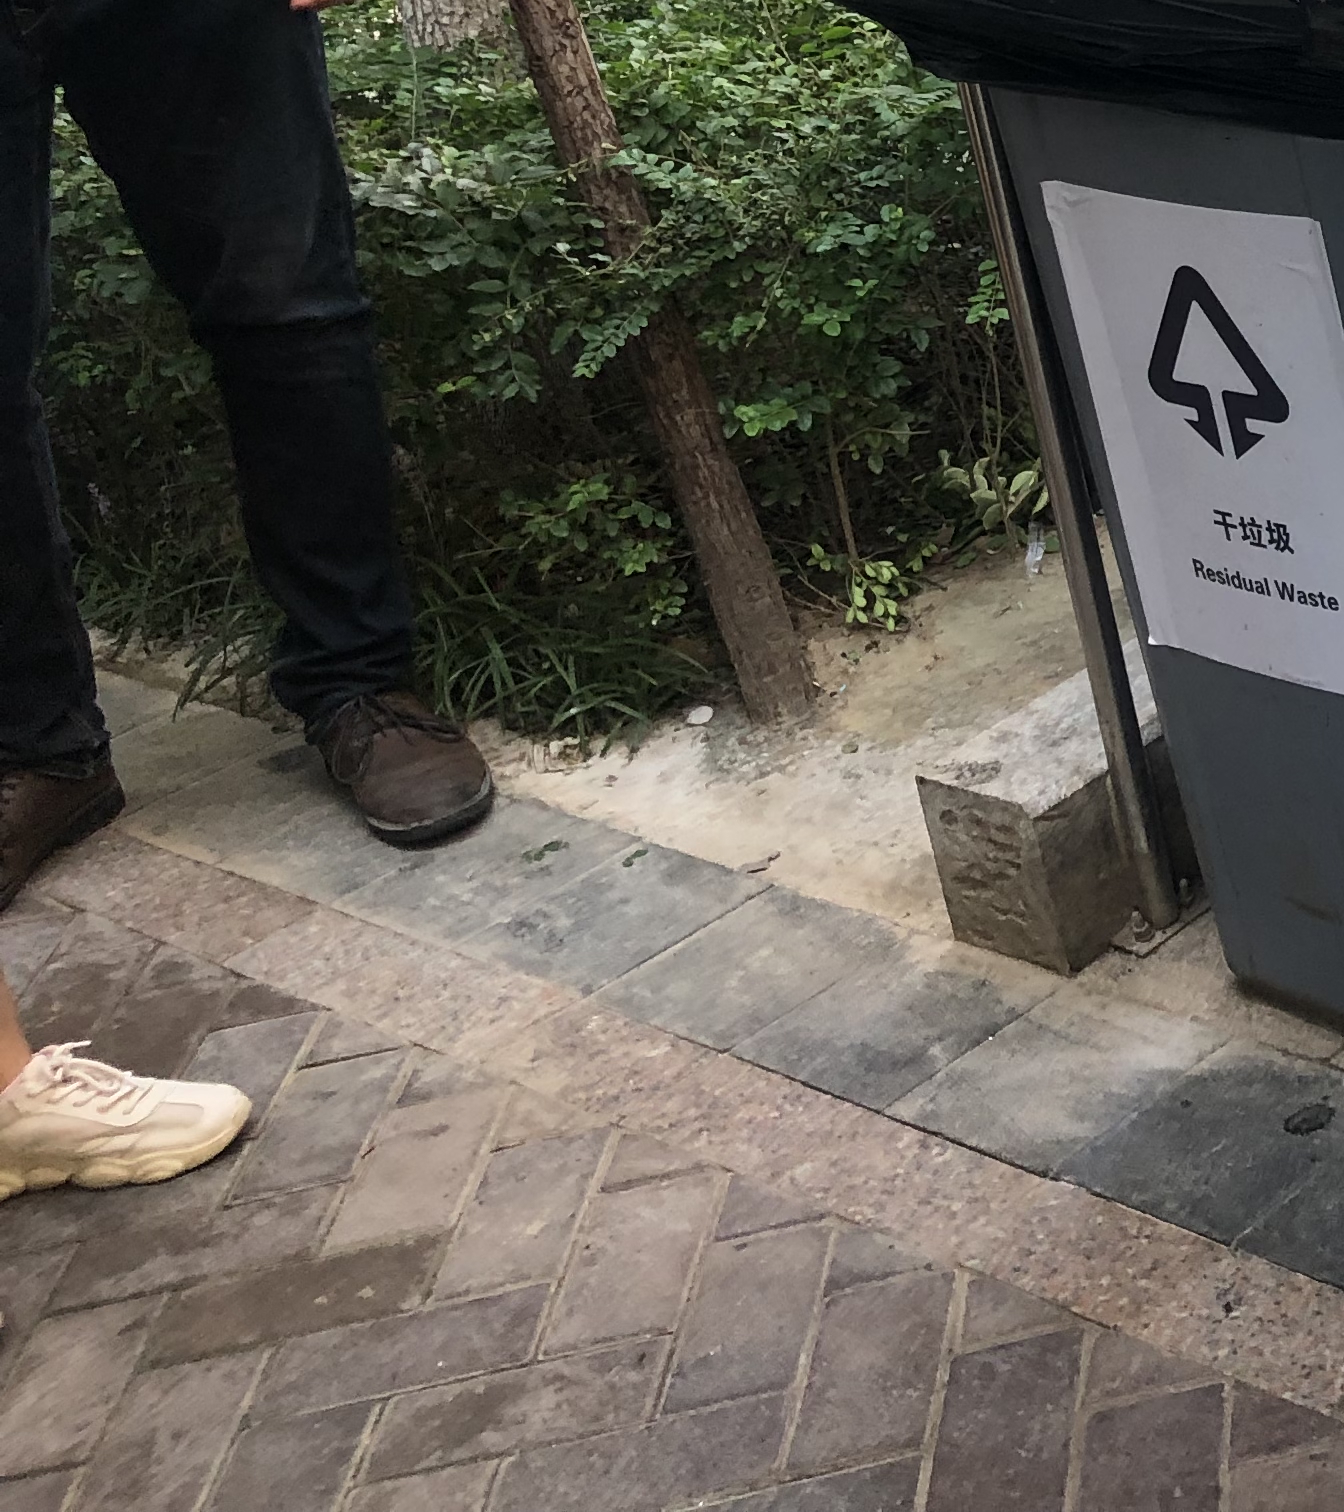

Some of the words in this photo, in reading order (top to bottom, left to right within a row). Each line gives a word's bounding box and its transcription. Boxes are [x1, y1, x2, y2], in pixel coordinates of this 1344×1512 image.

[1213, 508, 1296, 555] 干垃圾
[1191, 557, 1272, 599] Residual
[1273, 579, 1341, 613] Waste
